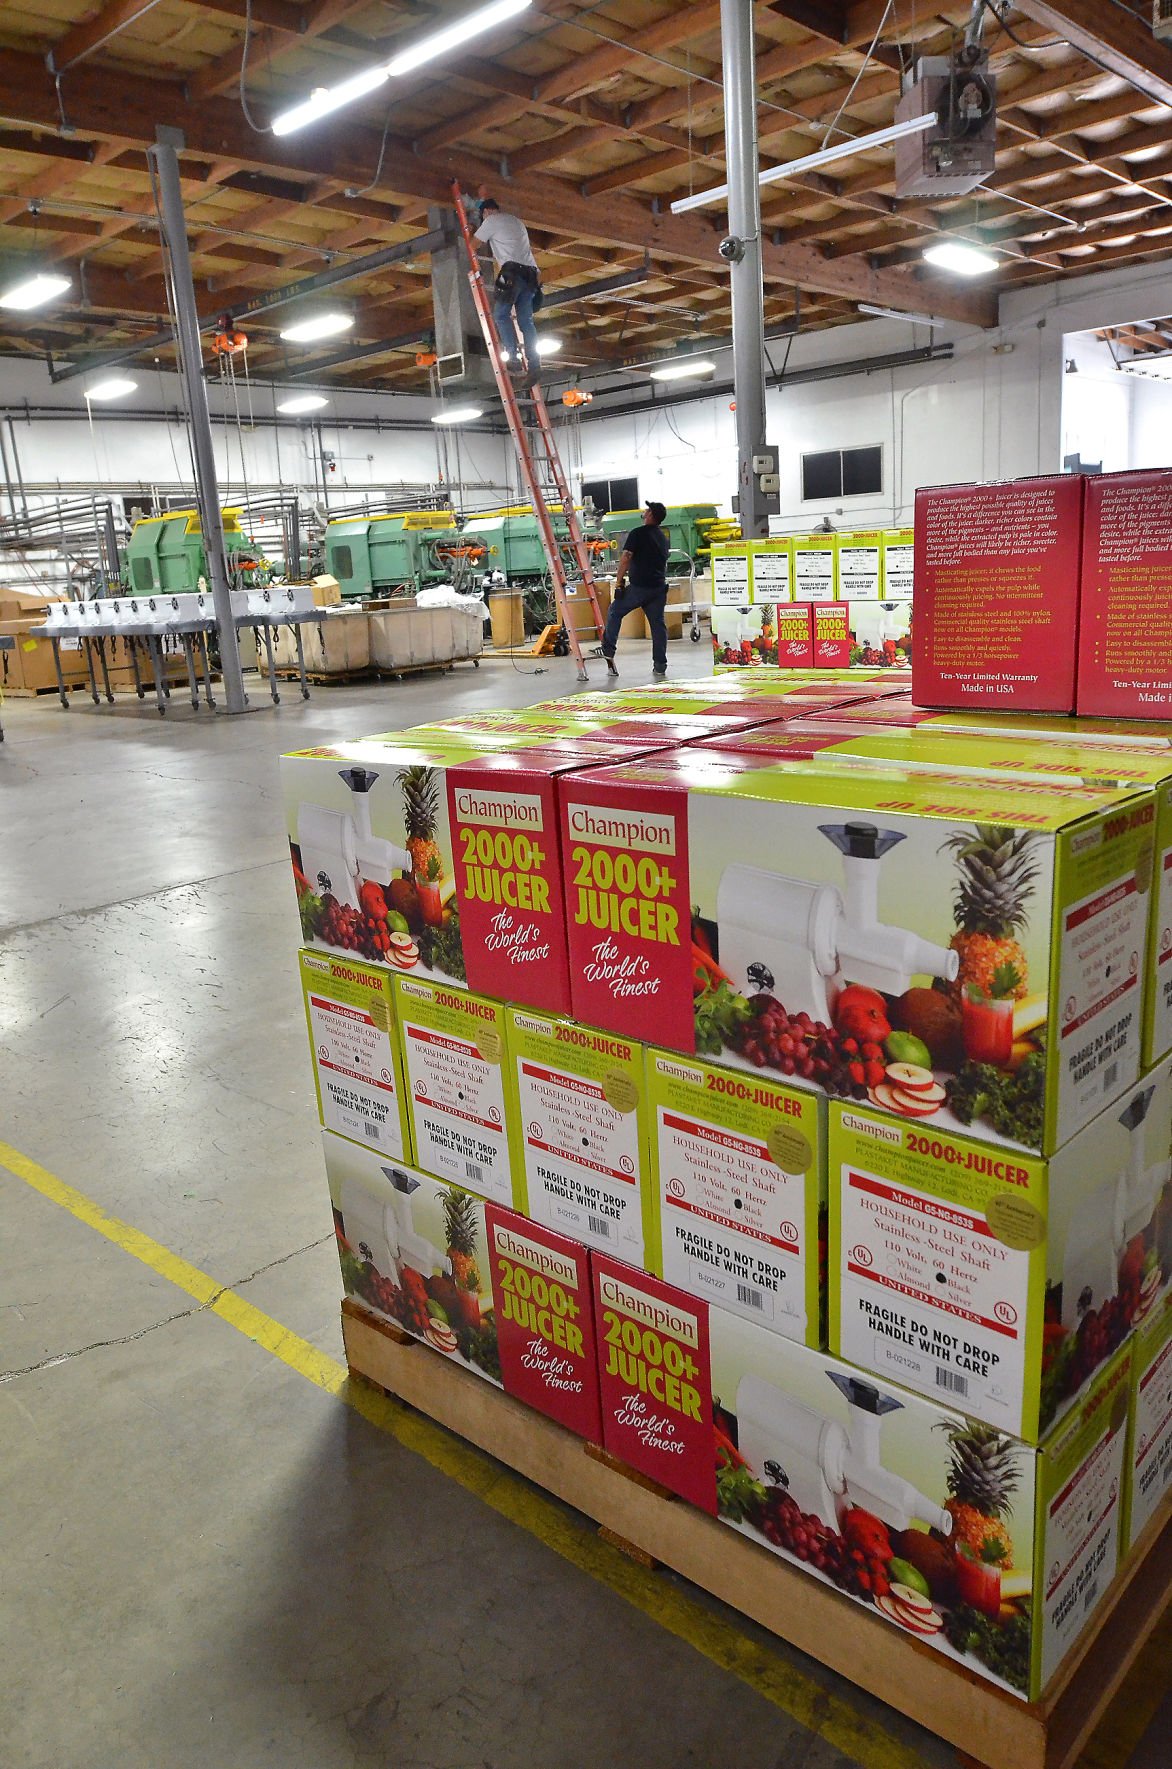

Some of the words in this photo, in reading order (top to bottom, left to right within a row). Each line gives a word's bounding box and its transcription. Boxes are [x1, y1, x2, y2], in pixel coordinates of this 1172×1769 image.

[781, 610, 808, 618] Champion
[781, 620, 808, 630] 2000+
[817, 608, 845, 617] Champion
[817, 619, 846, 630] 2000+
[781, 630, 809, 640] JUICER
[817, 630, 846, 640] JUICER
[996, 685, 1014, 693] USA
[1139, 693, 1165, 702] Made
[458, 795, 538, 825] Champion
[875, 800, 914, 810] UP
[920, 805, 982, 816] SIDE
[986, 811, 1051, 823] THIS
[572, 811, 671, 846] Champion
[460, 828, 545, 871] 2000+
[464, 866, 552, 913] JUICER
[572, 847, 677, 898] 2000+
[490, 907, 513, 932] The
[575, 887, 680, 945] JUICER
[485, 927, 540, 950] World's
[507, 944, 550, 964] Finest
[592, 936, 619, 960] The
[304, 958, 329, 973] Champion
[331, 964, 383, 991] 2000+JUICER
[583, 956, 650, 981] World's
[402, 983, 432, 999] Champion
[435, 991, 496, 1023] 2000+JUICER
[609, 977, 661, 998] Finest
[514, 1016, 551, 1034] Champion
[555, 1026, 632, 1061] 2000+JUICER
[327, 1082, 349, 1098] FRAGILE
[350, 1091, 358, 1101] DO
[360, 1095, 371, 1108] NOT
[373, 1102, 390, 1115] DROP
[656, 1061, 702, 1084] Champion
[707, 1074, 802, 1118] 2000+JUICER
[332, 1094, 353, 1110] HANDLE
[355, 1104, 370, 1117] WITH
[371, 1110, 386, 1123] CARE
[424, 1119, 449, 1138] FRAGILE
[451, 1130, 461, 1142] DO
[462, 1135, 476, 1149] NOT
[478, 1142, 497, 1156] DROP
[430, 1132, 454, 1152] HANDLE
[457, 1142, 473, 1158] WITH
[476, 1151, 493, 1166] CARE
[697, 1128, 721, 1143] Model
[842, 1115, 900, 1143] Champion
[906, 1133, 1030, 1189] 2000+JUICER
[672, 1135, 734, 1166] HOUSEHOLD
[737, 1160, 757, 1175] USE
[760, 1167, 788, 1184] ONLY
[684, 1153, 721, 1173] Stainless
[752, 1176, 776, 1194] Shaft
[537, 1166, 567, 1188] FRAGILE
[570, 1179, 582, 1191] DO
[584, 1184, 600, 1198] NOT
[603, 1191, 627, 1209] DROP
[544, 1182, 574, 1202] HANDLE
[576, 1193, 597, 1210] WITH
[600, 1201, 621, 1220] CARE
[693, 1172, 707, 1183] 110
[731, 1185, 741, 1196] 60
[745, 1189, 767, 1206] Hertz
[892, 1191, 922, 1210] Model
[690, 1205, 728, 1226] UNITED
[731, 1220, 772, 1243] STATES
[860, 1198, 939, 1235] HOUSEHOLD
[944, 1228, 967, 1246] USE
[972, 1238, 1008, 1262] ONLY
[496, 1232, 574, 1280] Champion
[676, 1226, 713, 1252] FRAGILE
[716, 1243, 731, 1257] DO
[734, 1250, 753, 1268] NOT
[757, 1260, 787, 1281] DROP
[873, 1217, 921, 1243] Stainless
[960, 1248, 992, 1271] Shaft
[683, 1242, 720, 1268] HANDLE
[723, 1258, 749, 1280] WITH
[752, 1270, 778, 1292] CARE
[884, 1240, 902, 1253] 110
[932, 1256, 945, 1269] 60
[950, 1262, 978, 1284] Hertz
[896, 1256, 922, 1275] White
[948, 1278, 971, 1295] Black
[498, 1260, 580, 1320] 2000+
[878, 1275, 928, 1301] UNITED
[932, 1295, 983, 1325] STATES
[896, 1270, 931, 1291] Almond
[948, 1291, 972, 1308] Silver
[502, 1293, 585, 1358] JUICER
[603, 1280, 694, 1339] Champion
[527, 1338, 548, 1356] The
[603, 1311, 699, 1382] 2000+
[859, 1299, 906, 1328] FRAGILE
[911, 1320, 928, 1337] DO
[932, 1328, 958, 1349] NOT
[963, 1340, 1000, 1366] DROP
[868, 1317, 915, 1347] HANDLE
[918, 1336, 950, 1361] WITH
[955, 1352, 989, 1377] CARE
[520, 1354, 574, 1376] World's
[542, 1372, 583, 1392] Finest
[606, 1344, 702, 1424] JUICER
[622, 1394, 646, 1413] The
[614, 1409, 675, 1435] World's
[638, 1430, 685, 1454] Finest
